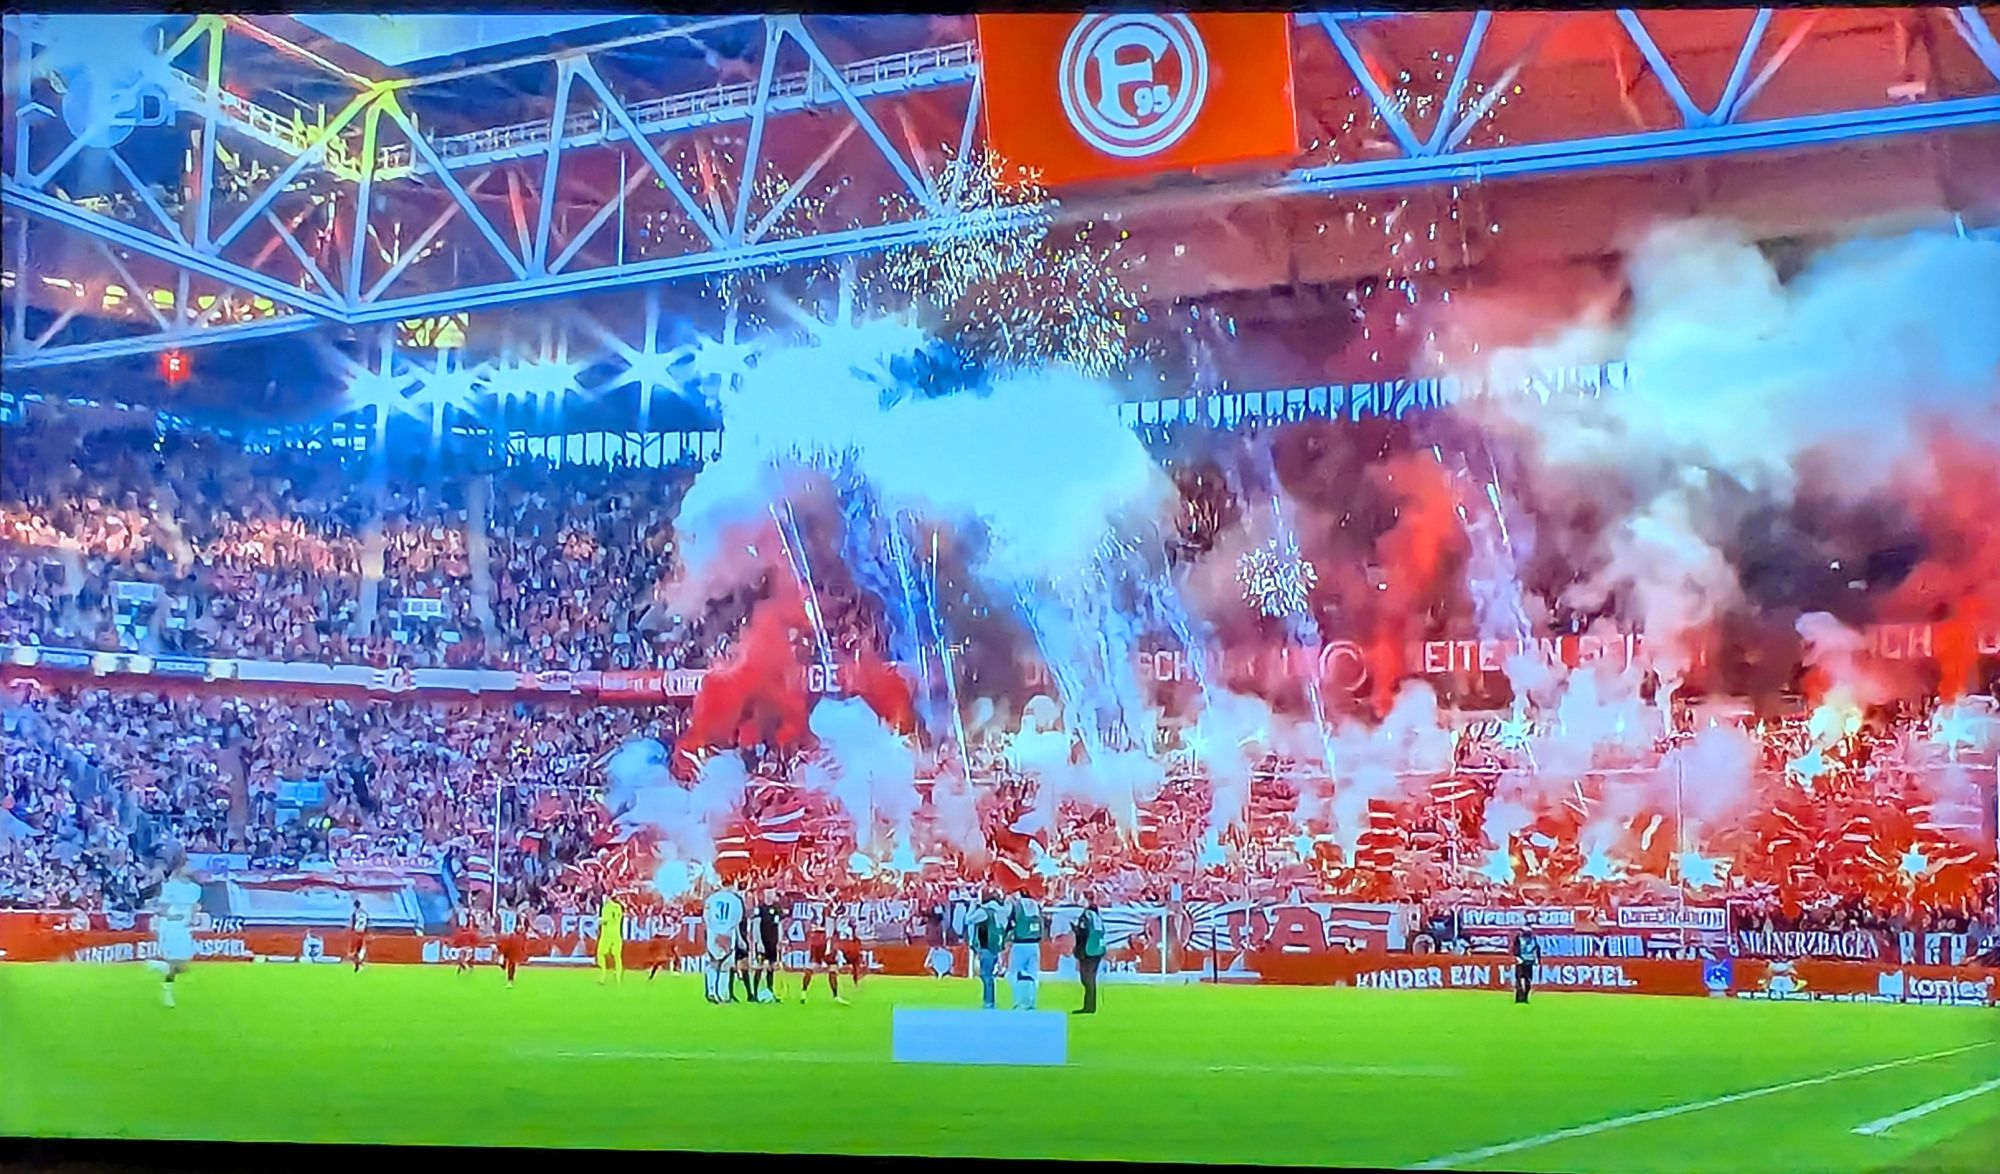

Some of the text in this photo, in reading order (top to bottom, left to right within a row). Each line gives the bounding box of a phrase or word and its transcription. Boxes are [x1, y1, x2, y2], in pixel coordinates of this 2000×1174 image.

[1355, 964, 1639, 990] KINDER EIN HIMSPIEL.
